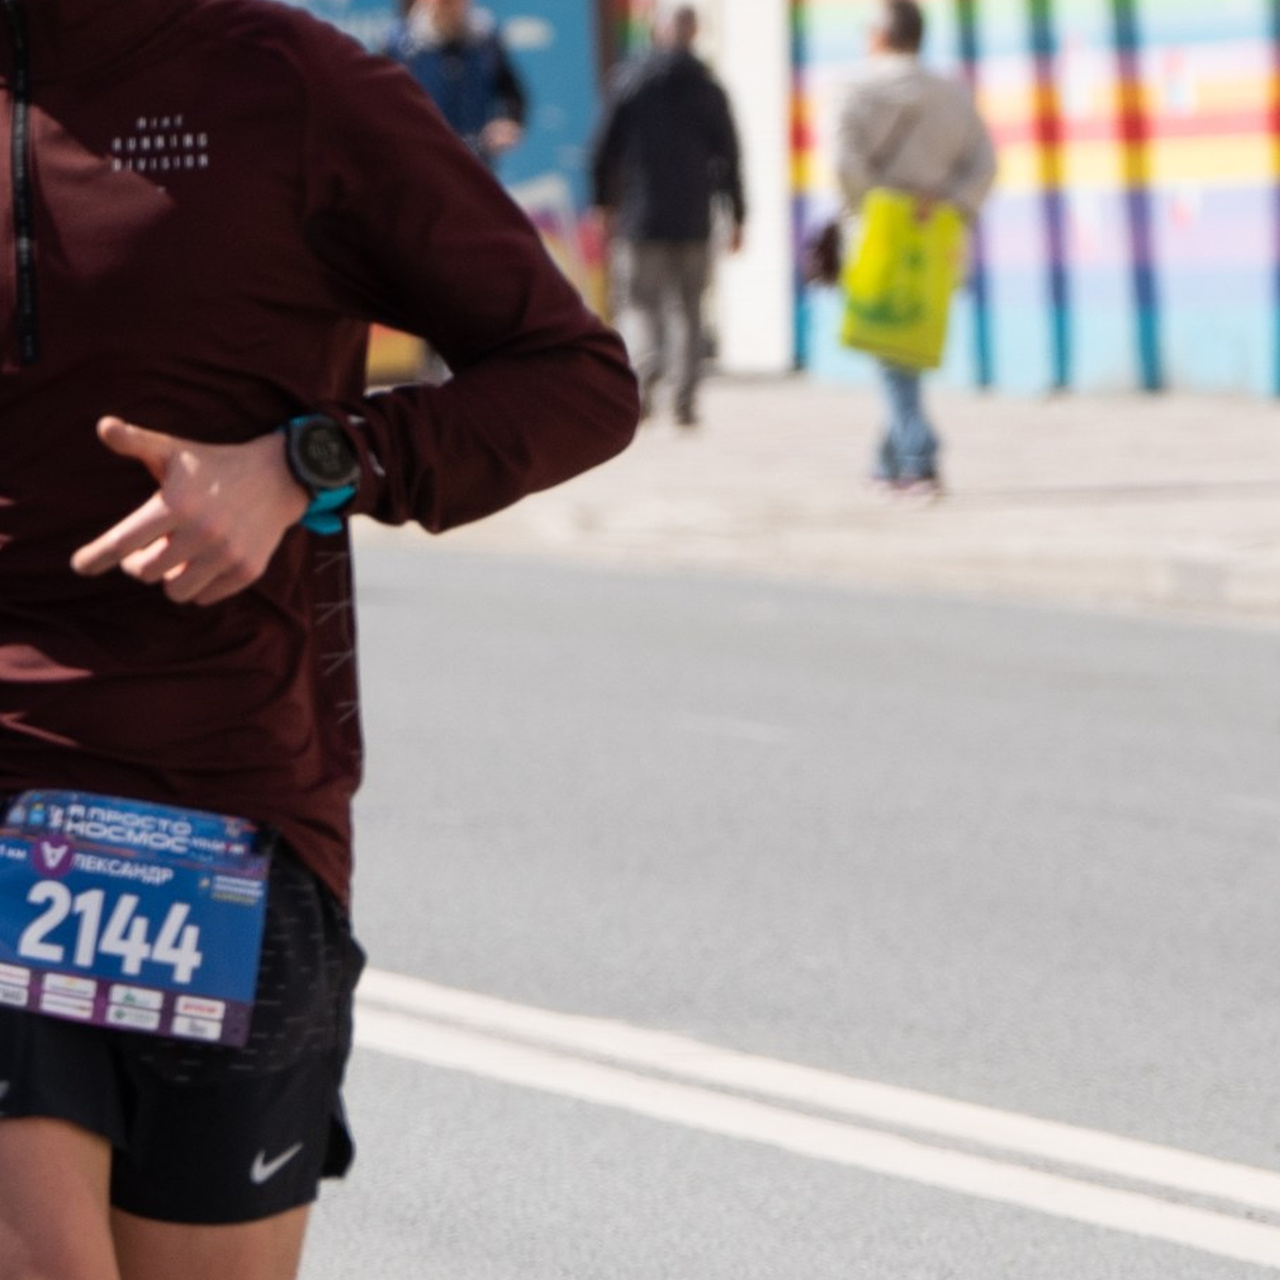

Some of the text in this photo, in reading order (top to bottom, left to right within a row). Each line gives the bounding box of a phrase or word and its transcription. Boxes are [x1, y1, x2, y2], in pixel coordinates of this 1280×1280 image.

[111, 132, 208, 152] RUNNING
[111, 153, 209, 173] DIVISION
[72, 851, 175, 887] ЛЕКСАНДР
[17, 880, 203, 985] 2144
